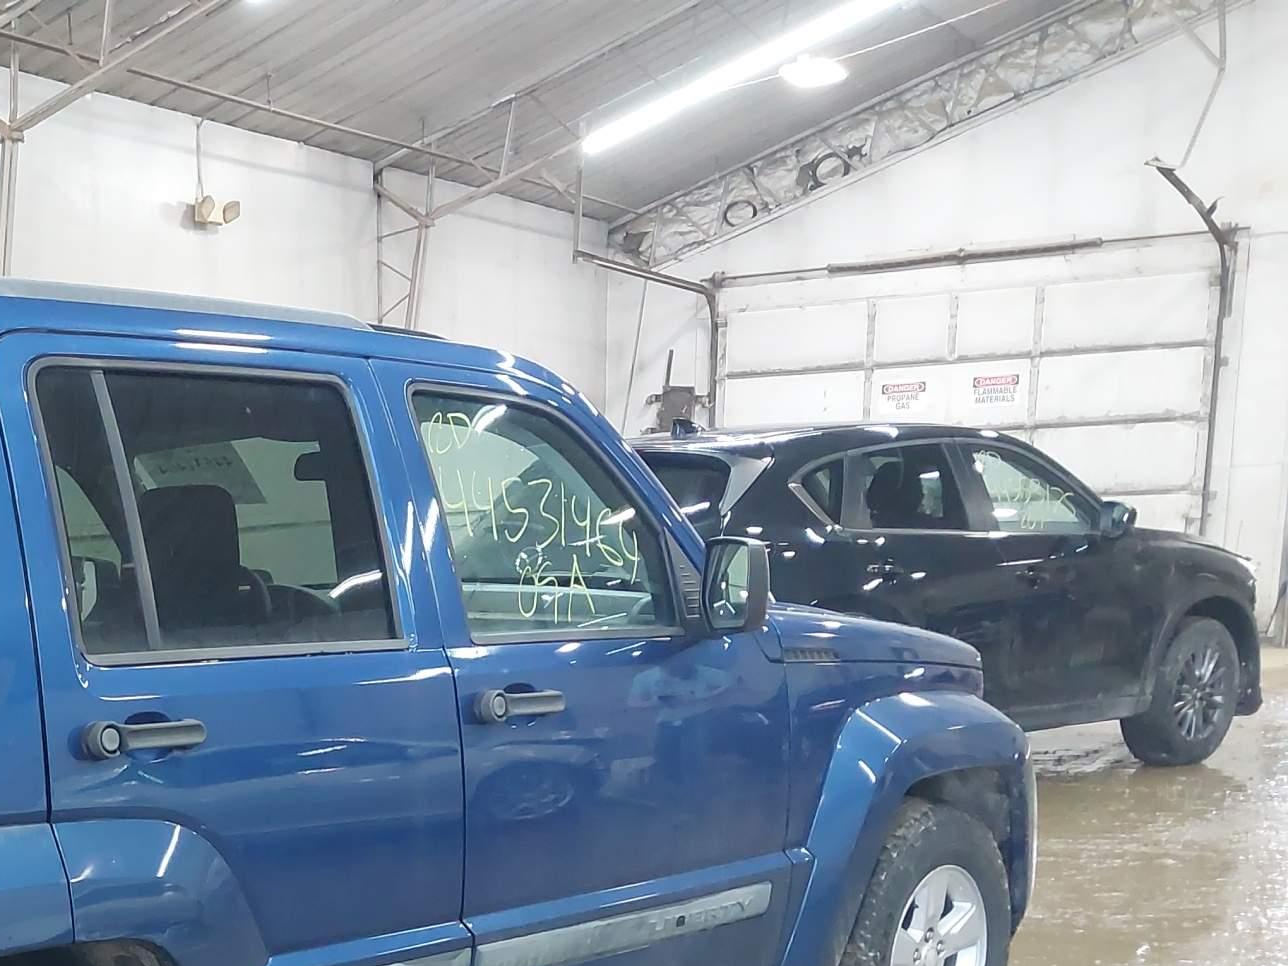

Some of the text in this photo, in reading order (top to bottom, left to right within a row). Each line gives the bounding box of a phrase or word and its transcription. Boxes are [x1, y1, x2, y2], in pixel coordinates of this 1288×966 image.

[978, 375, 1012, 386] DANGER
[887, 383, 919, 393] DANGER
[973, 385, 1017, 396] FLAMMABLE
[887, 392, 920, 402] PROPANE
[975, 394, 1015, 404] MATERIALS
[895, 402, 910, 410] GAS
